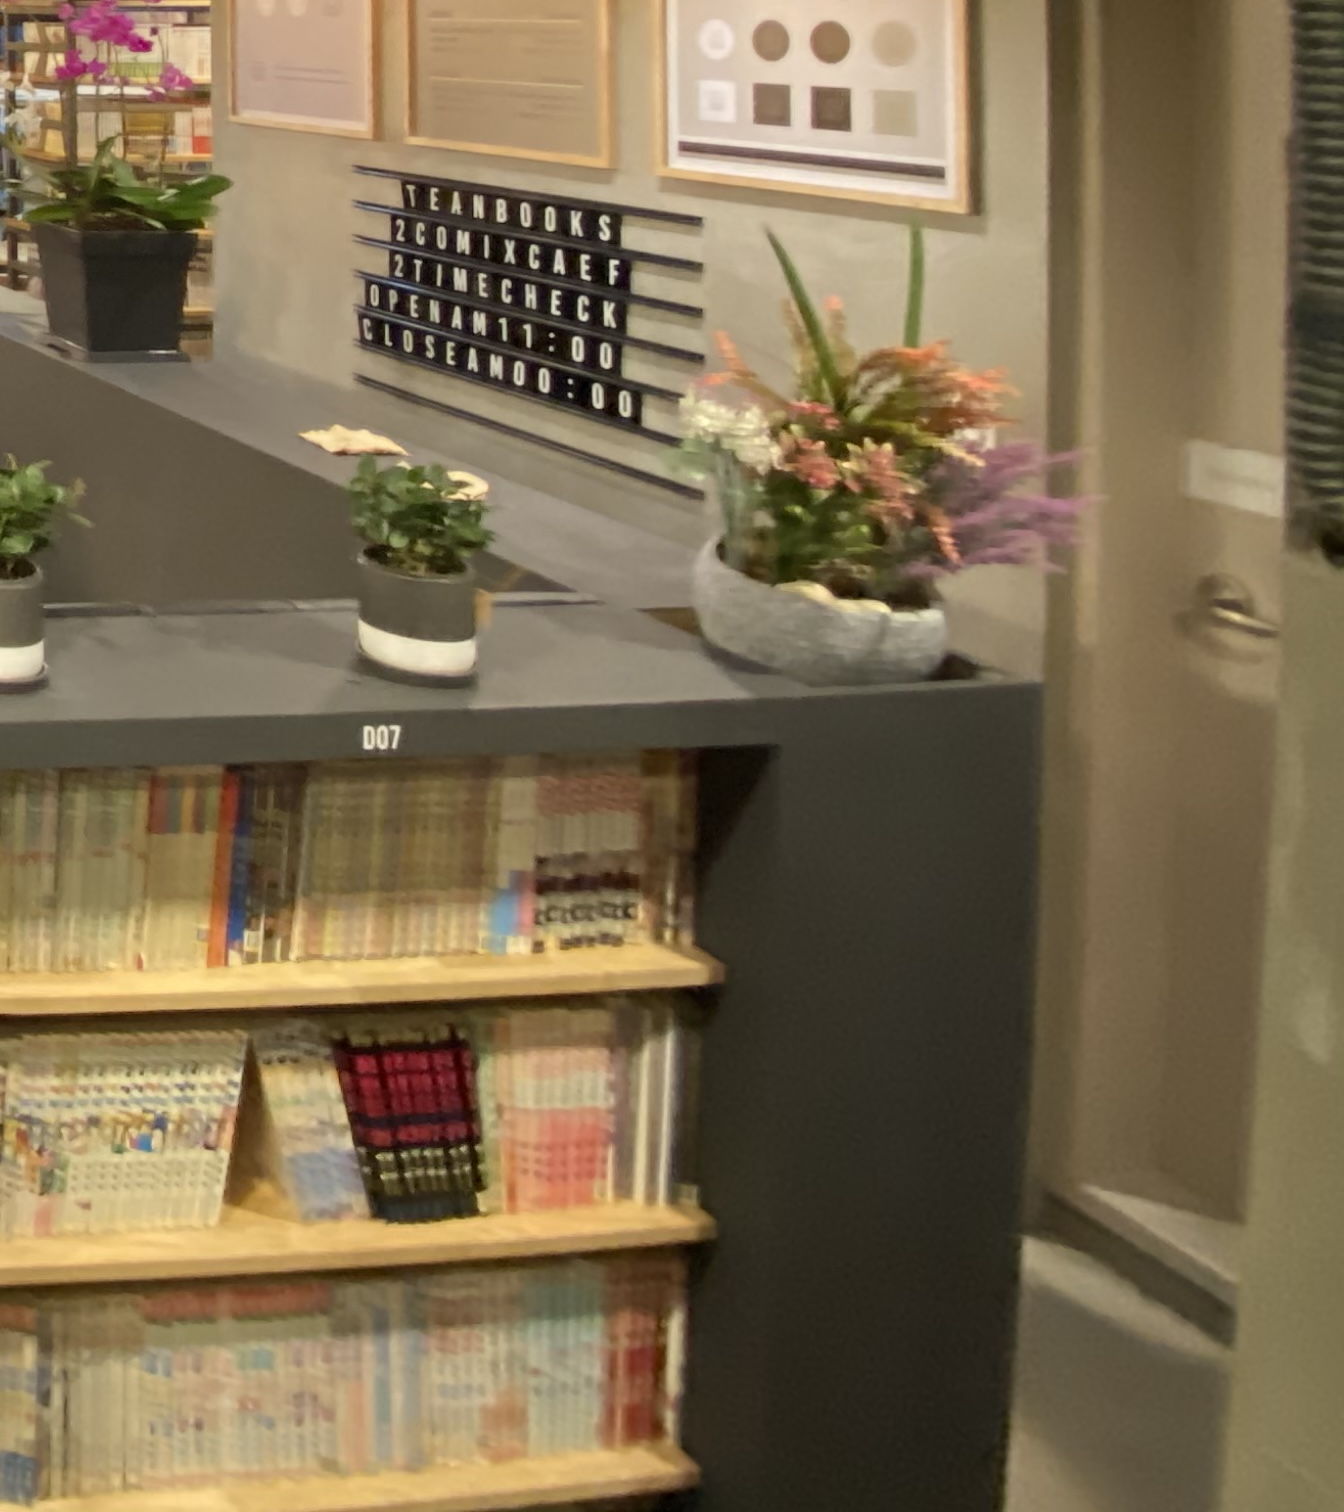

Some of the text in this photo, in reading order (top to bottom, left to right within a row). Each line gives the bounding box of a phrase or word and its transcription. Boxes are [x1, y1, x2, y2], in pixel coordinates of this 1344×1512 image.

[406, 185, 611, 241] TEANBOOKS
[395, 219, 620, 286] 2COMIXCAEF
[393, 254, 617, 328] 2TIMECHECK
[362, 724, 402, 750] D07
